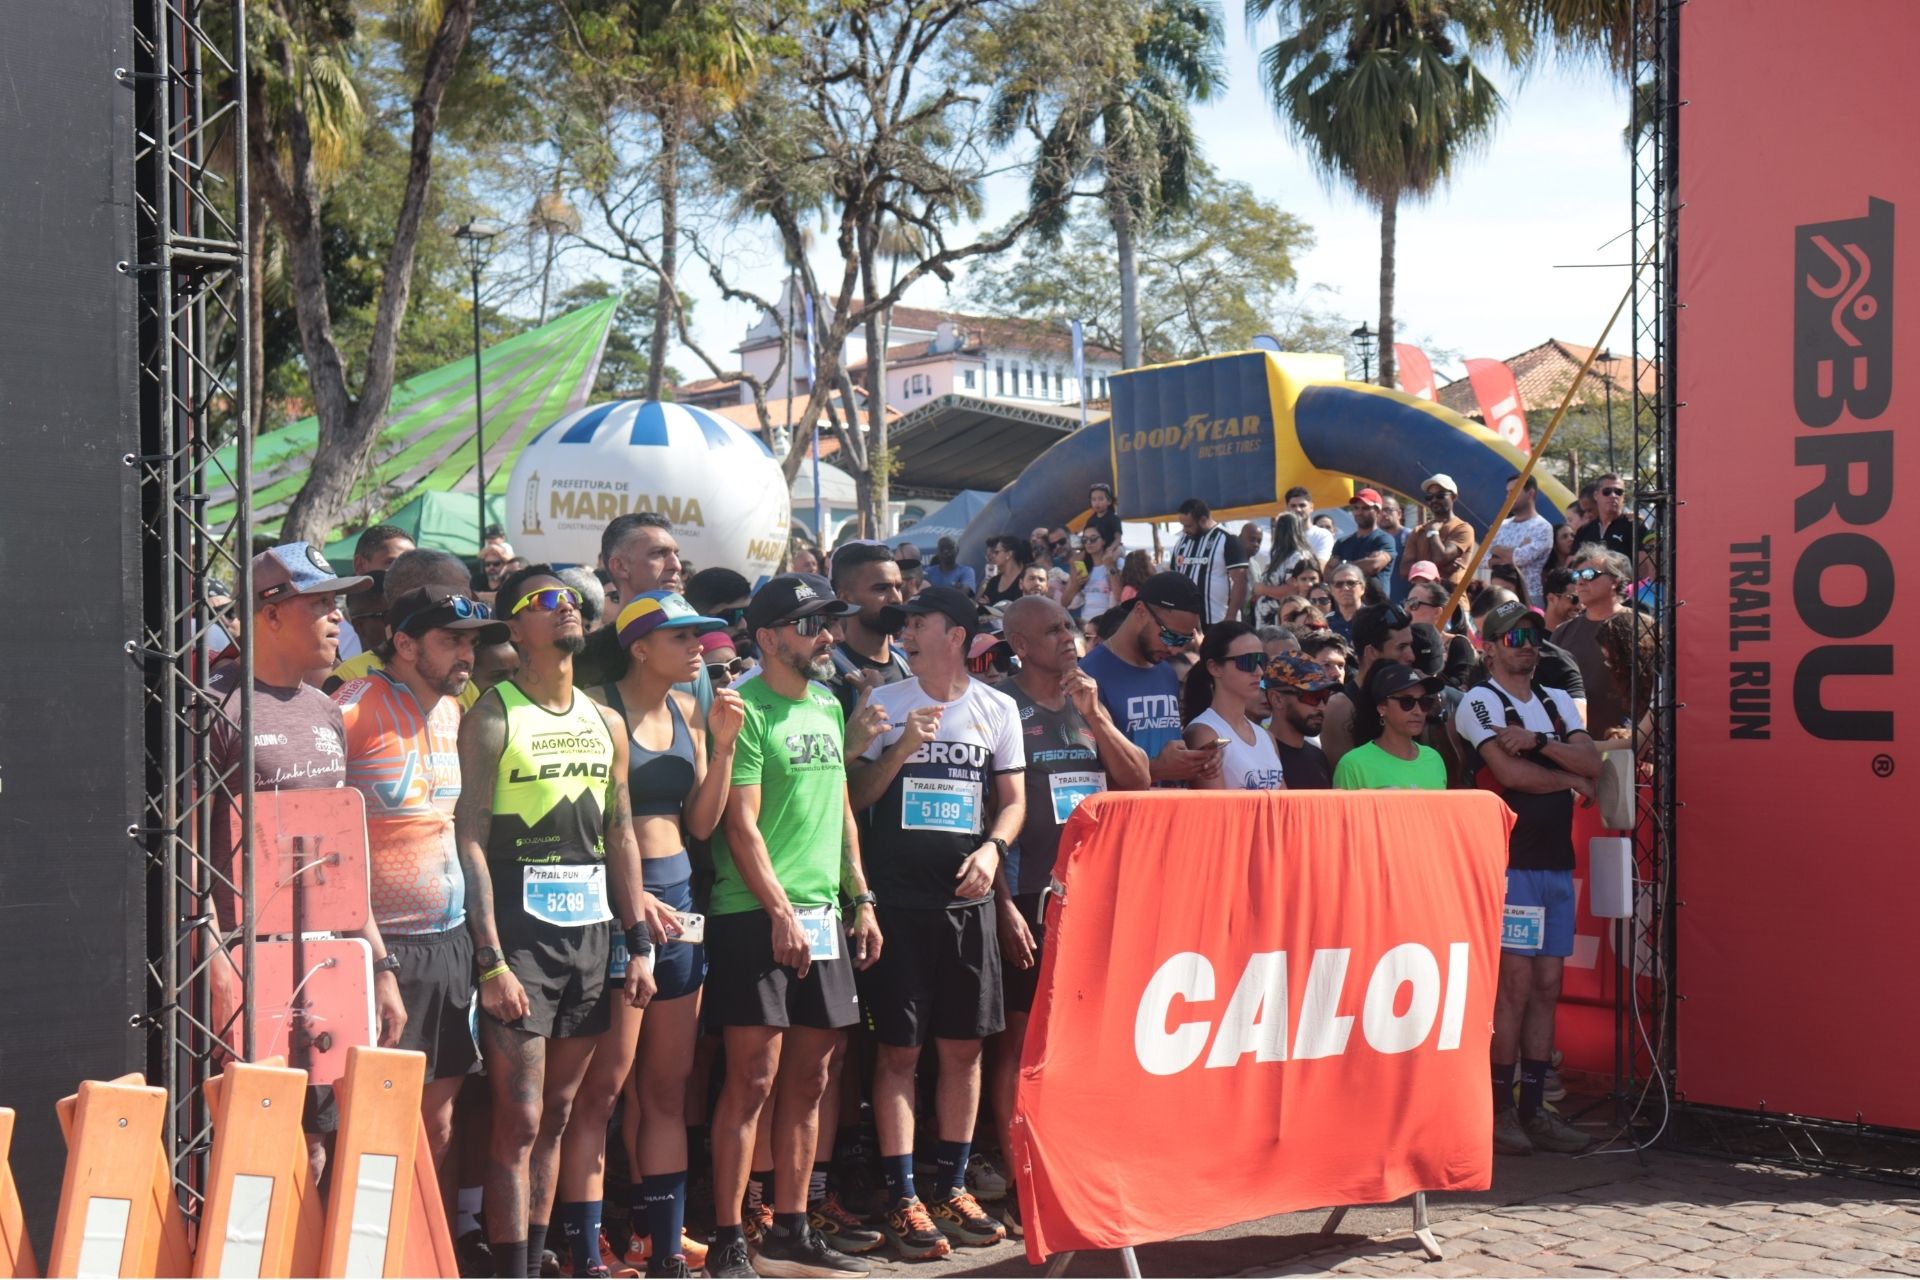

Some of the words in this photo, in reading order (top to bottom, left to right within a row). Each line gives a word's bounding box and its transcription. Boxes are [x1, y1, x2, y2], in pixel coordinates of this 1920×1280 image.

[1236, 439, 1261, 454] TIRES
[551, 479, 613, 490] PREFEITURA
[615, 482, 629, 491] DE
[550, 490, 705, 527] MARIANA
[1729, 535, 1771, 652] TRAIL
[1729, 661, 1771, 740] RUN
[531, 738, 595, 751] MAGMOTOS
[948, 767, 969, 780] TRAIL
[1059, 775, 1077, 784] TRAIL
[914, 782, 935, 790] TRAIL
[937, 783, 954, 791] RUN
[921, 801, 960, 819] 5189
[535, 871, 561, 880] TRAIL
[547, 892, 584, 912] 5289
[1134, 942, 1469, 1076] CALOI
